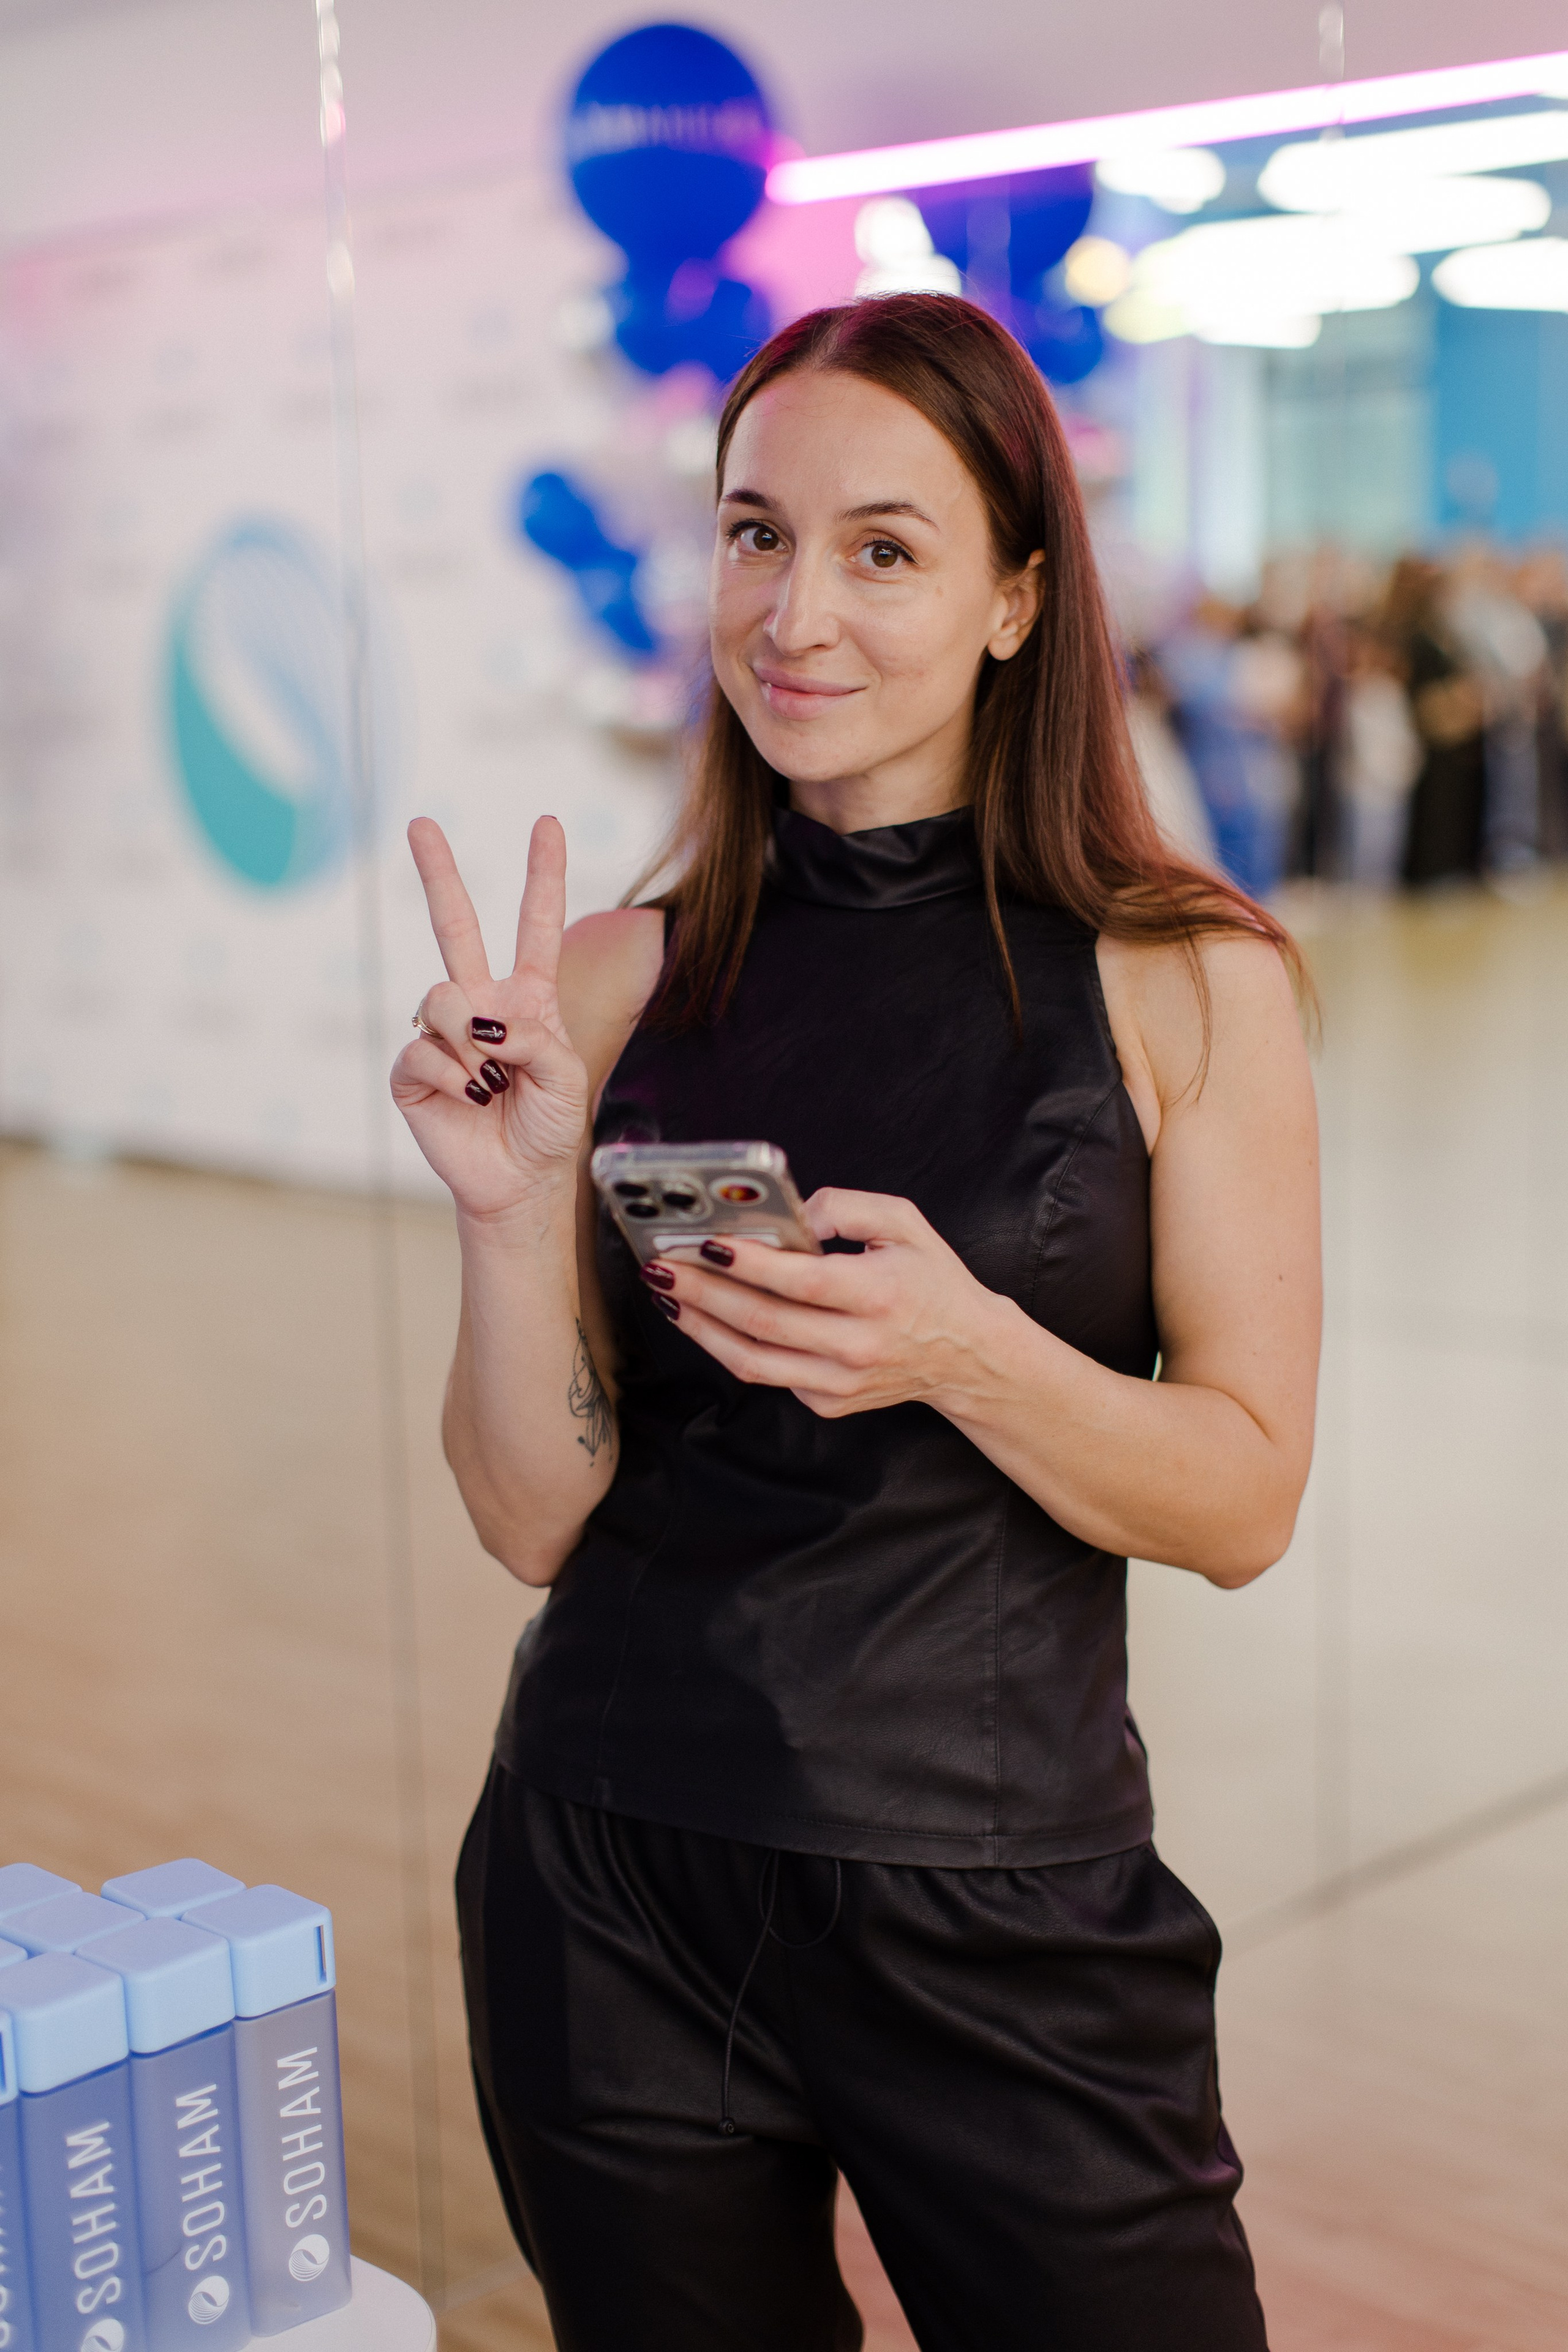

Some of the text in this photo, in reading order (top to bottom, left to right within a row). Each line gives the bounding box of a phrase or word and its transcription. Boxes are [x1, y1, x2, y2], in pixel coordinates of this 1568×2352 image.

[66, 2121, 121, 2315] SOHAM
[175, 2083, 227, 2271] SOHAM
[276, 2046, 327, 2228] SOHAM
